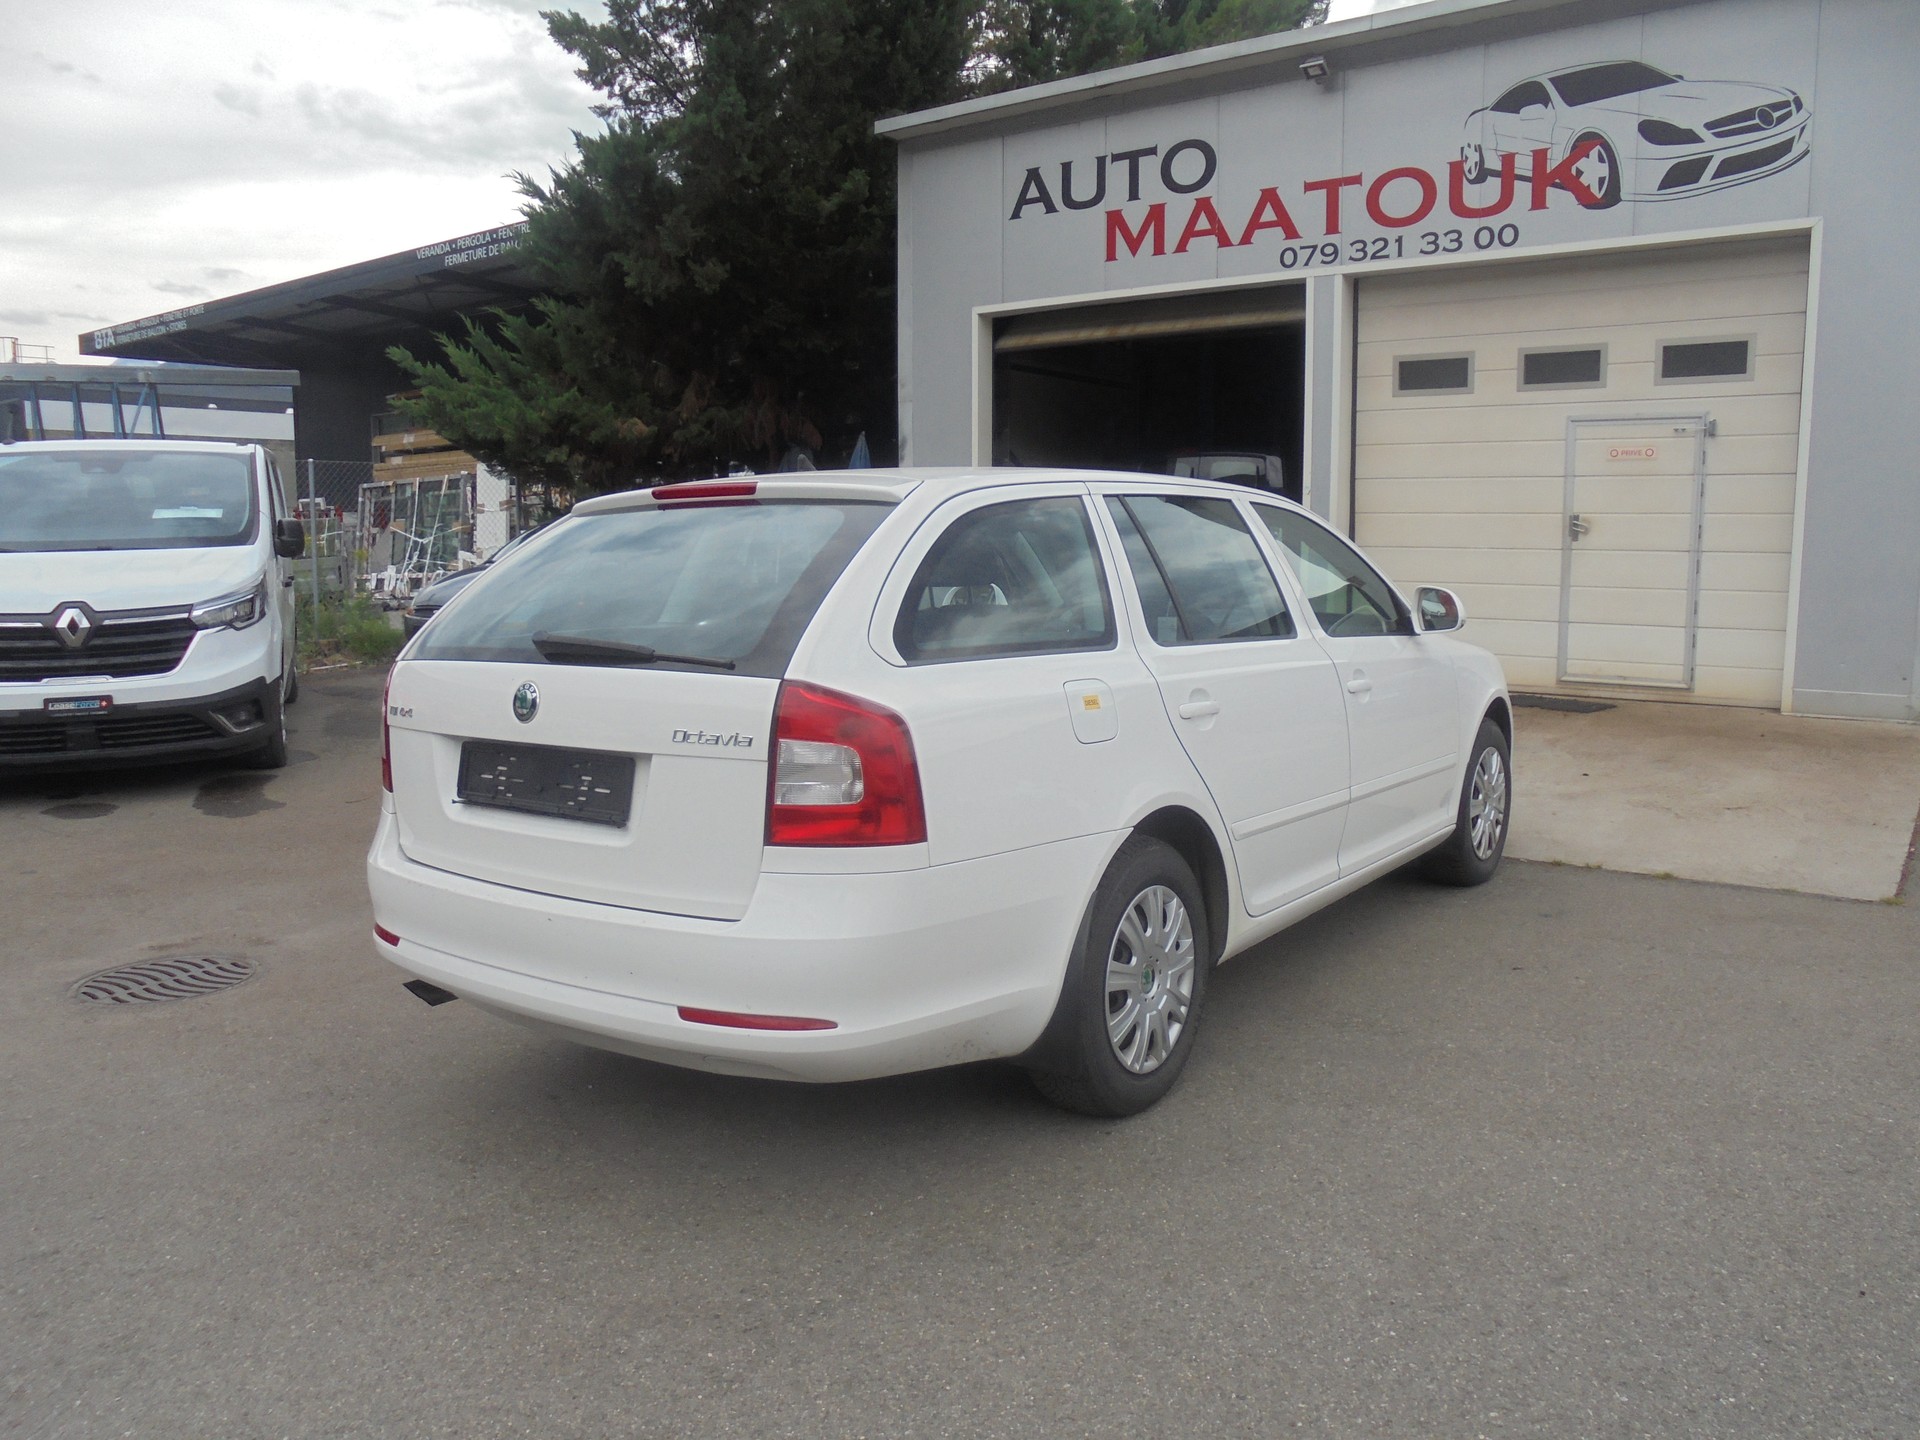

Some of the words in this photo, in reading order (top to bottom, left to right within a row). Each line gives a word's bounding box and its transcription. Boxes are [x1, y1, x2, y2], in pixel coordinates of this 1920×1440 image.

[1009, 138, 1217, 220] AUTO
[1104, 139, 1606, 262] MAATOUK
[416, 242, 451, 260] VERANDA
[457, 231, 492, 249] PERGOLA
[498, 222, 531, 240] FENTRE
[444, 246, 487, 267] FERMETURE
[488, 243, 499, 257] DE
[1279, 242, 1339, 268] 079
[1348, 235, 1404, 262] 321
[1419, 229, 1463, 255] 33
[1473, 223, 1520, 249] 00
[94, 328, 116, 350] BTA
[672, 728, 754, 747] Octavia
